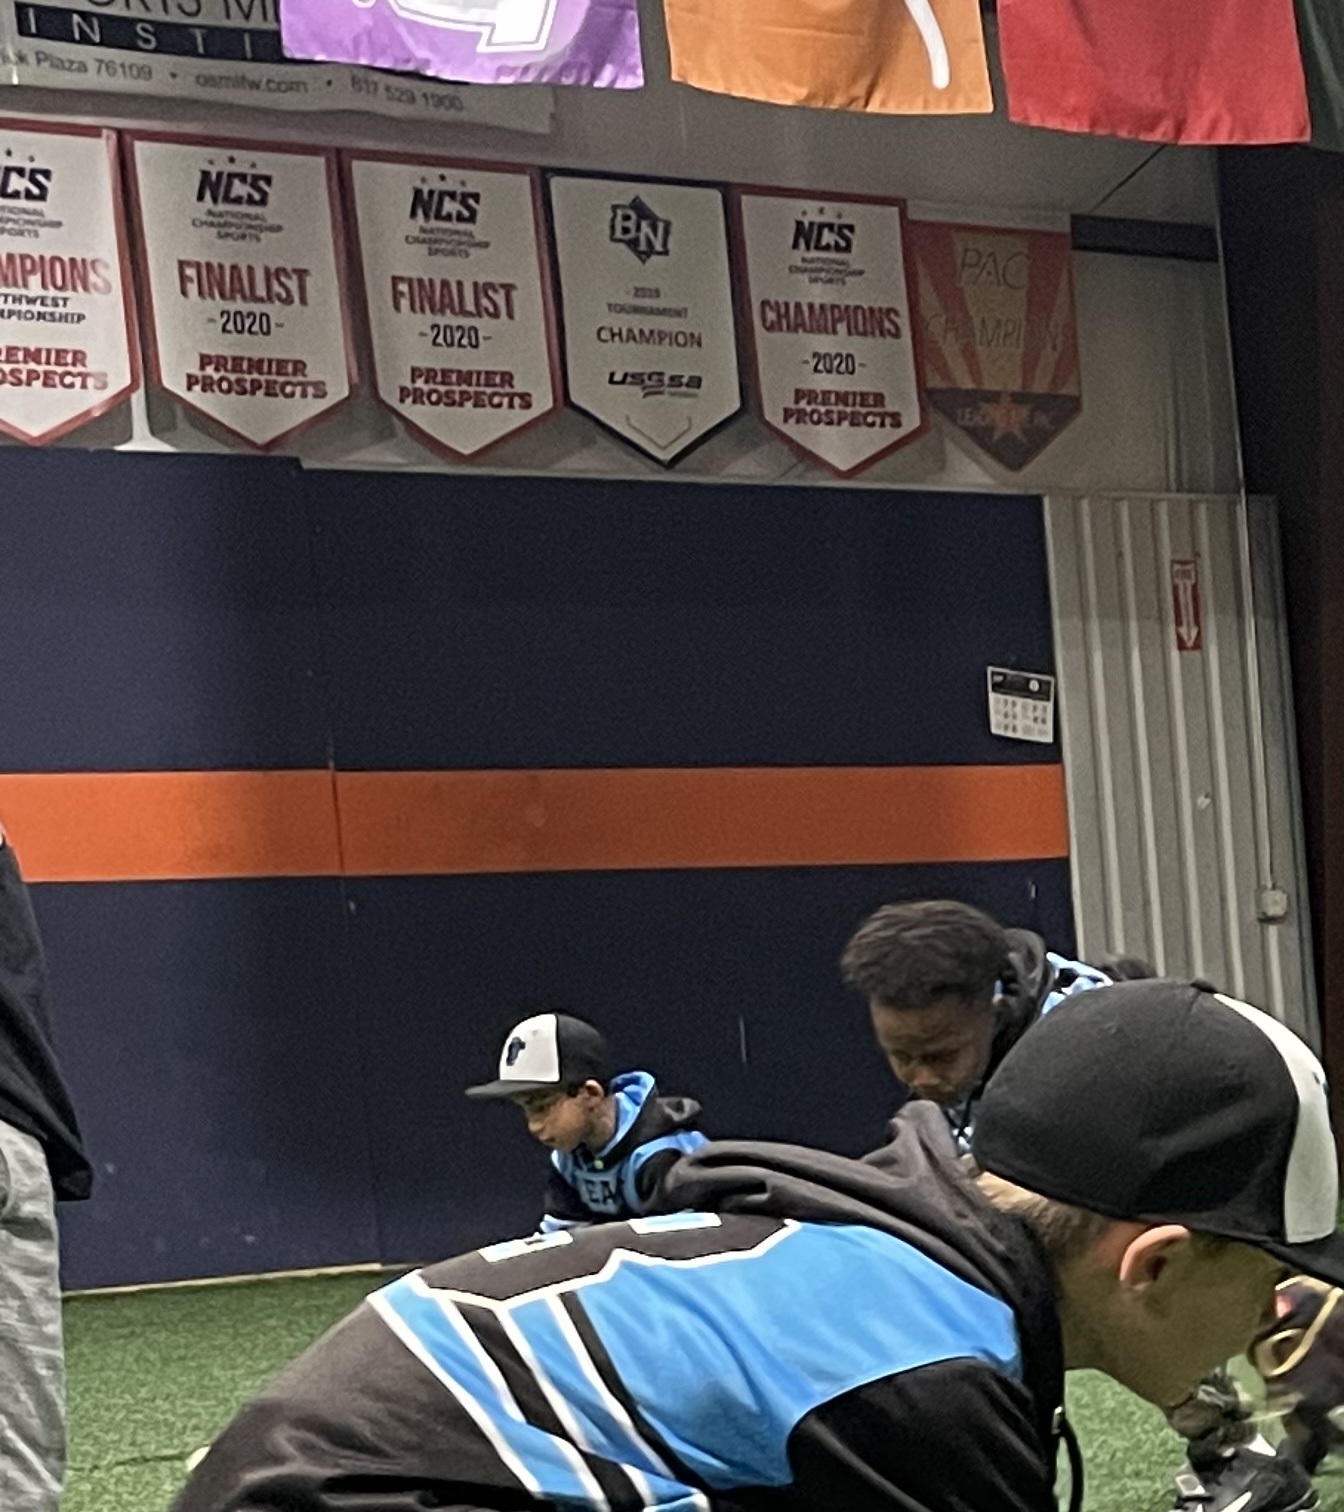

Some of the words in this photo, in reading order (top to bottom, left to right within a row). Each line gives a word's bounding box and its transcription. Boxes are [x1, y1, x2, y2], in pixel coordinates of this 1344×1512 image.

[34, 50, 88, 73] Plaza
[197, 169, 272, 207] NCS
[409, 187, 481, 224] NCS
[611, 205, 670, 255] BN
[791, 220, 855, 254] NCS
[177, 259, 311, 306] FINALIST
[391, 275, 518, 320] FINALIST
[760, 299, 901, 339] CHAMPIONS
[596, 326, 702, 348] CHAMPION
[0, 346, 87, 368] EMIER
[199, 352, 307, 377] PREMIER
[186, 373, 327, 399] PROSPECTS
[410, 366, 514, 388] PREMIER
[399, 386, 532, 410] PROSPECTS
[793, 388, 886, 408] PREMIER
[783, 407, 902, 429] PROSPECTS
